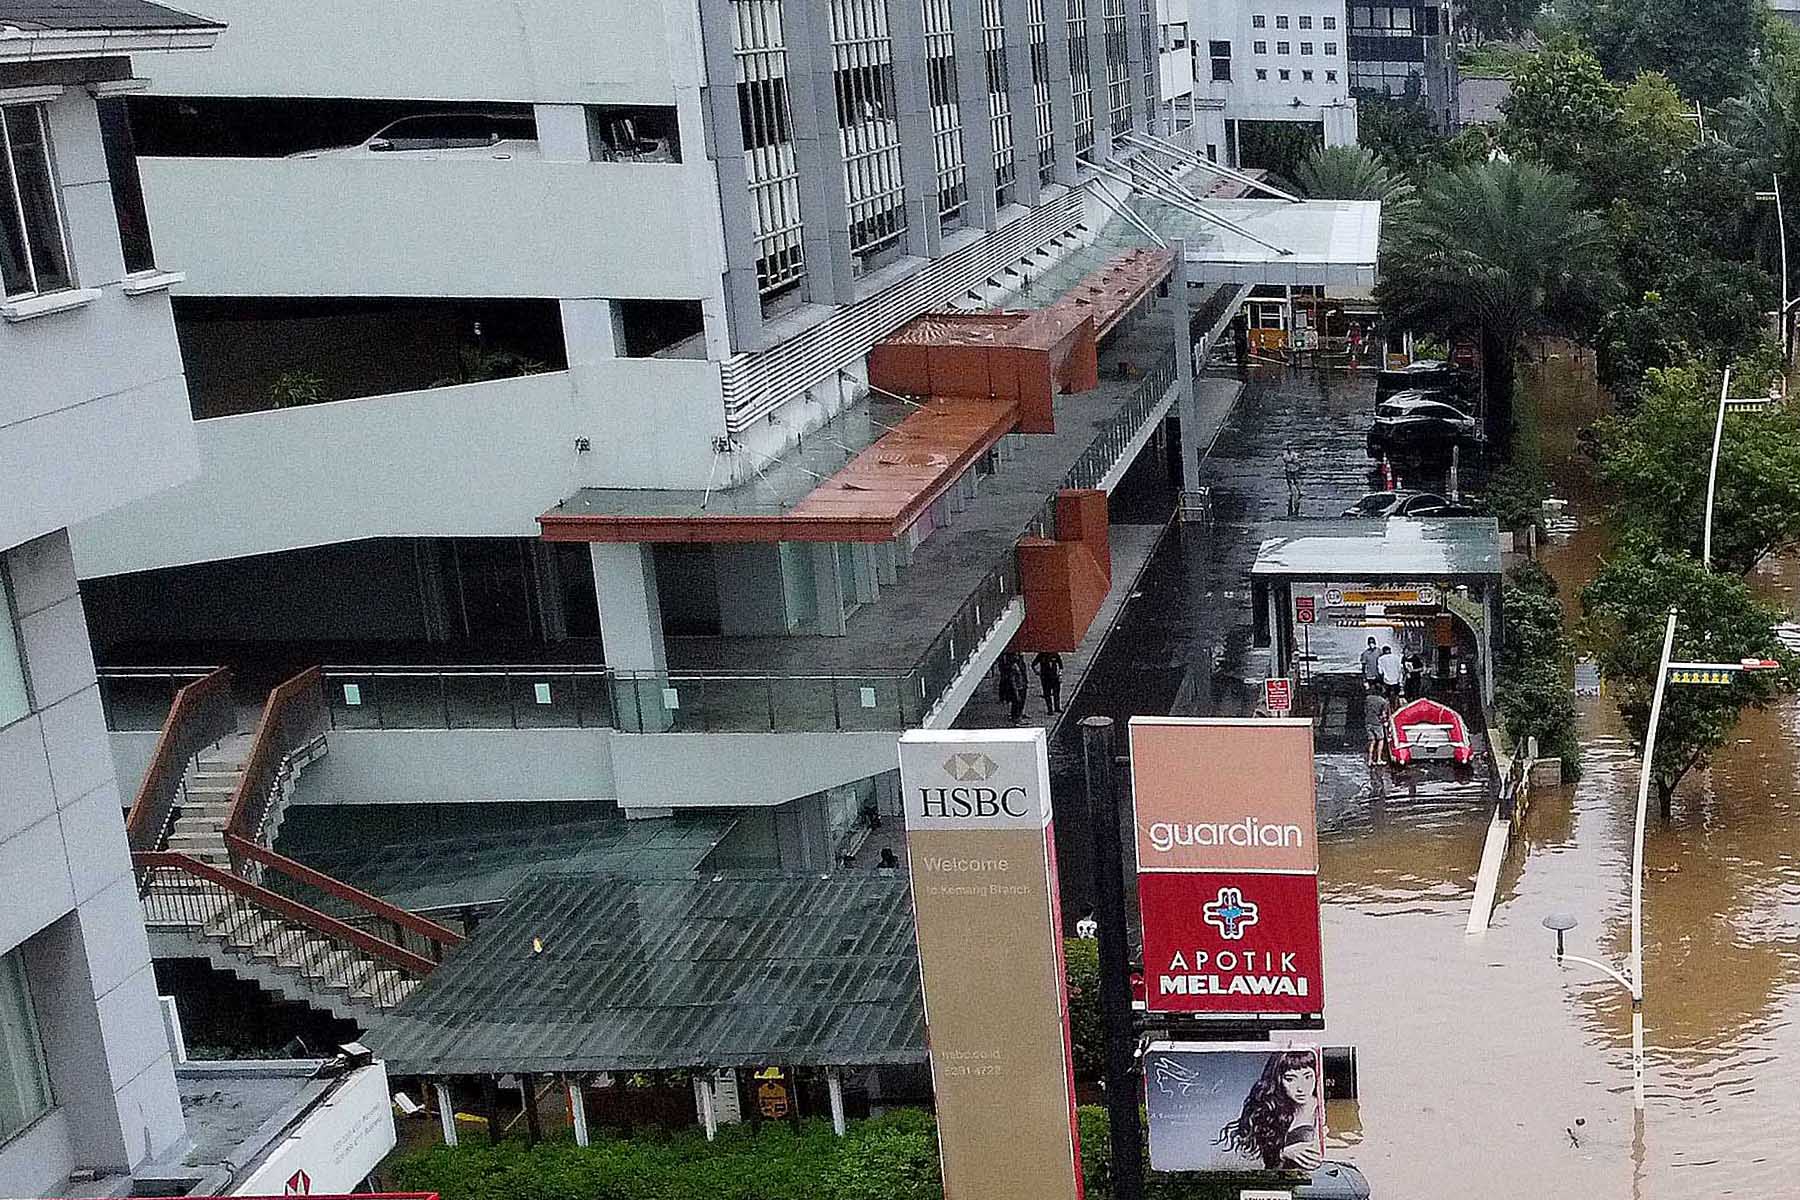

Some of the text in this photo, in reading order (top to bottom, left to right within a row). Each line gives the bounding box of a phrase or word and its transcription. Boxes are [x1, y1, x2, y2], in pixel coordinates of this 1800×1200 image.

[919, 787, 1029, 818] HSBC
[1150, 817, 1303, 851] guardian
[924, 857, 1010, 873] Welcome
[1169, 950, 1298, 973] APOTIK
[1159, 974, 1308, 997] MELAWAI
